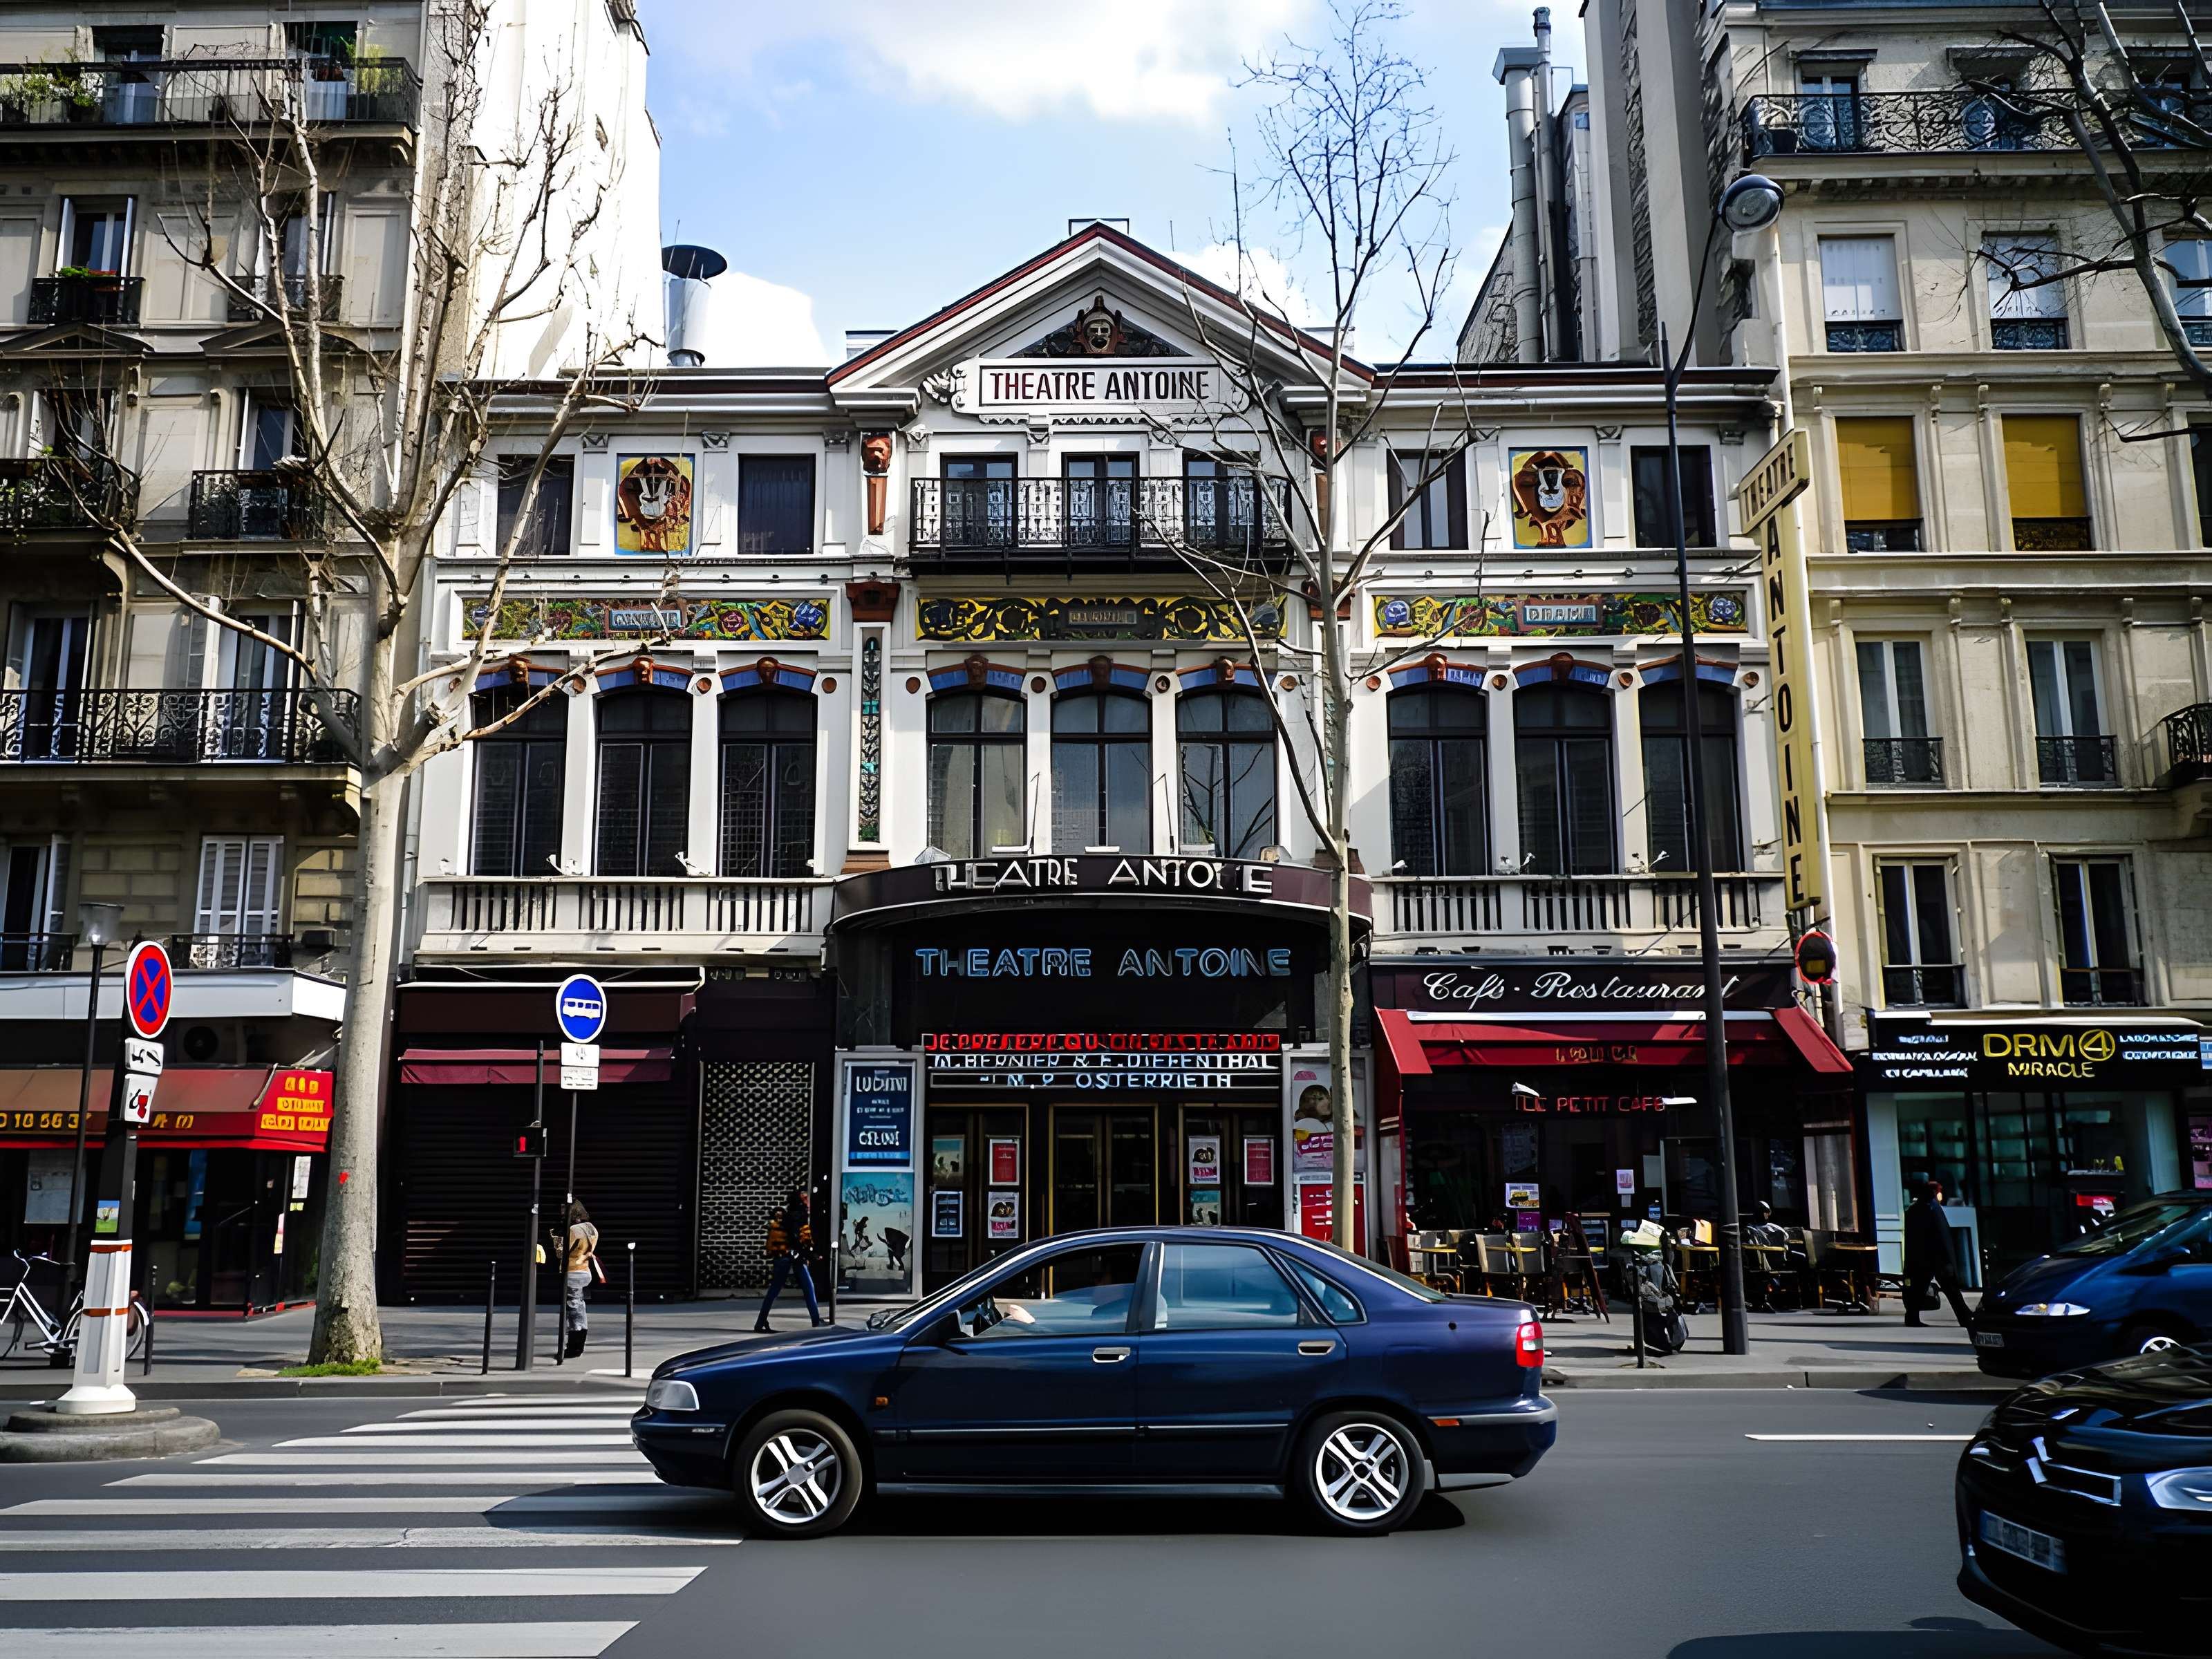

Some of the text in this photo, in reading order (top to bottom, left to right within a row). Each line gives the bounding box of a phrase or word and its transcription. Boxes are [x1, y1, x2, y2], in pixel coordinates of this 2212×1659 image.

[989, 370, 1210, 400] THEATRE ANTOINE
[1767, 514, 1803, 903] ANTOINE
[915, 948, 1291, 977] THEATRE ANTOINE
[2007, 1061, 2095, 1078] MIRACLE
[1557, 1097, 1609, 1112] PETIT
